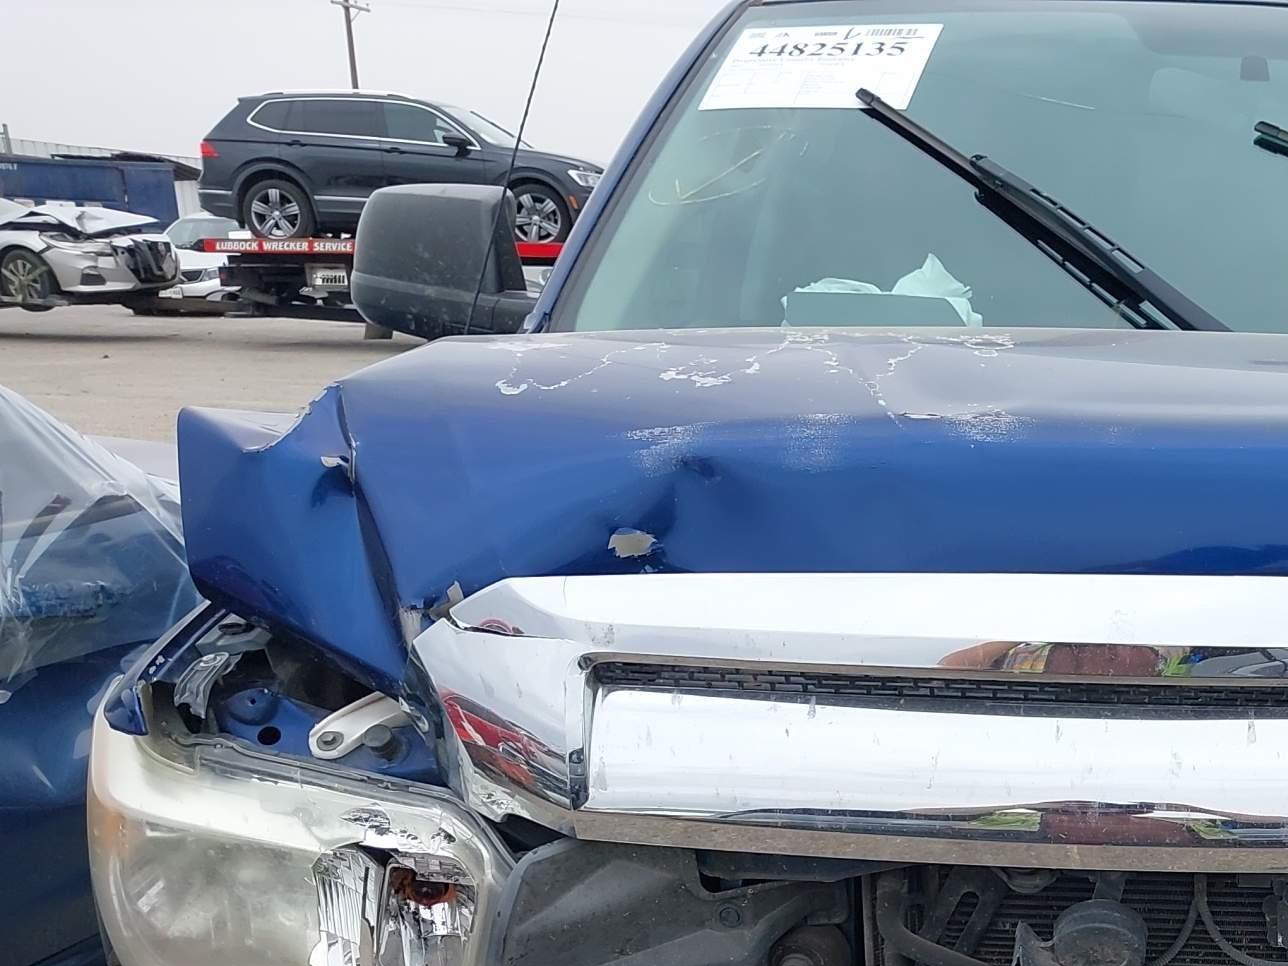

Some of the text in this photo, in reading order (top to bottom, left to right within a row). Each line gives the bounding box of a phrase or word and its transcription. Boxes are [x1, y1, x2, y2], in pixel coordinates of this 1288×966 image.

[748, 41, 909, 58] 44825135
[215, 240, 353, 252] LUBBOCK WRECKER SERVICE
